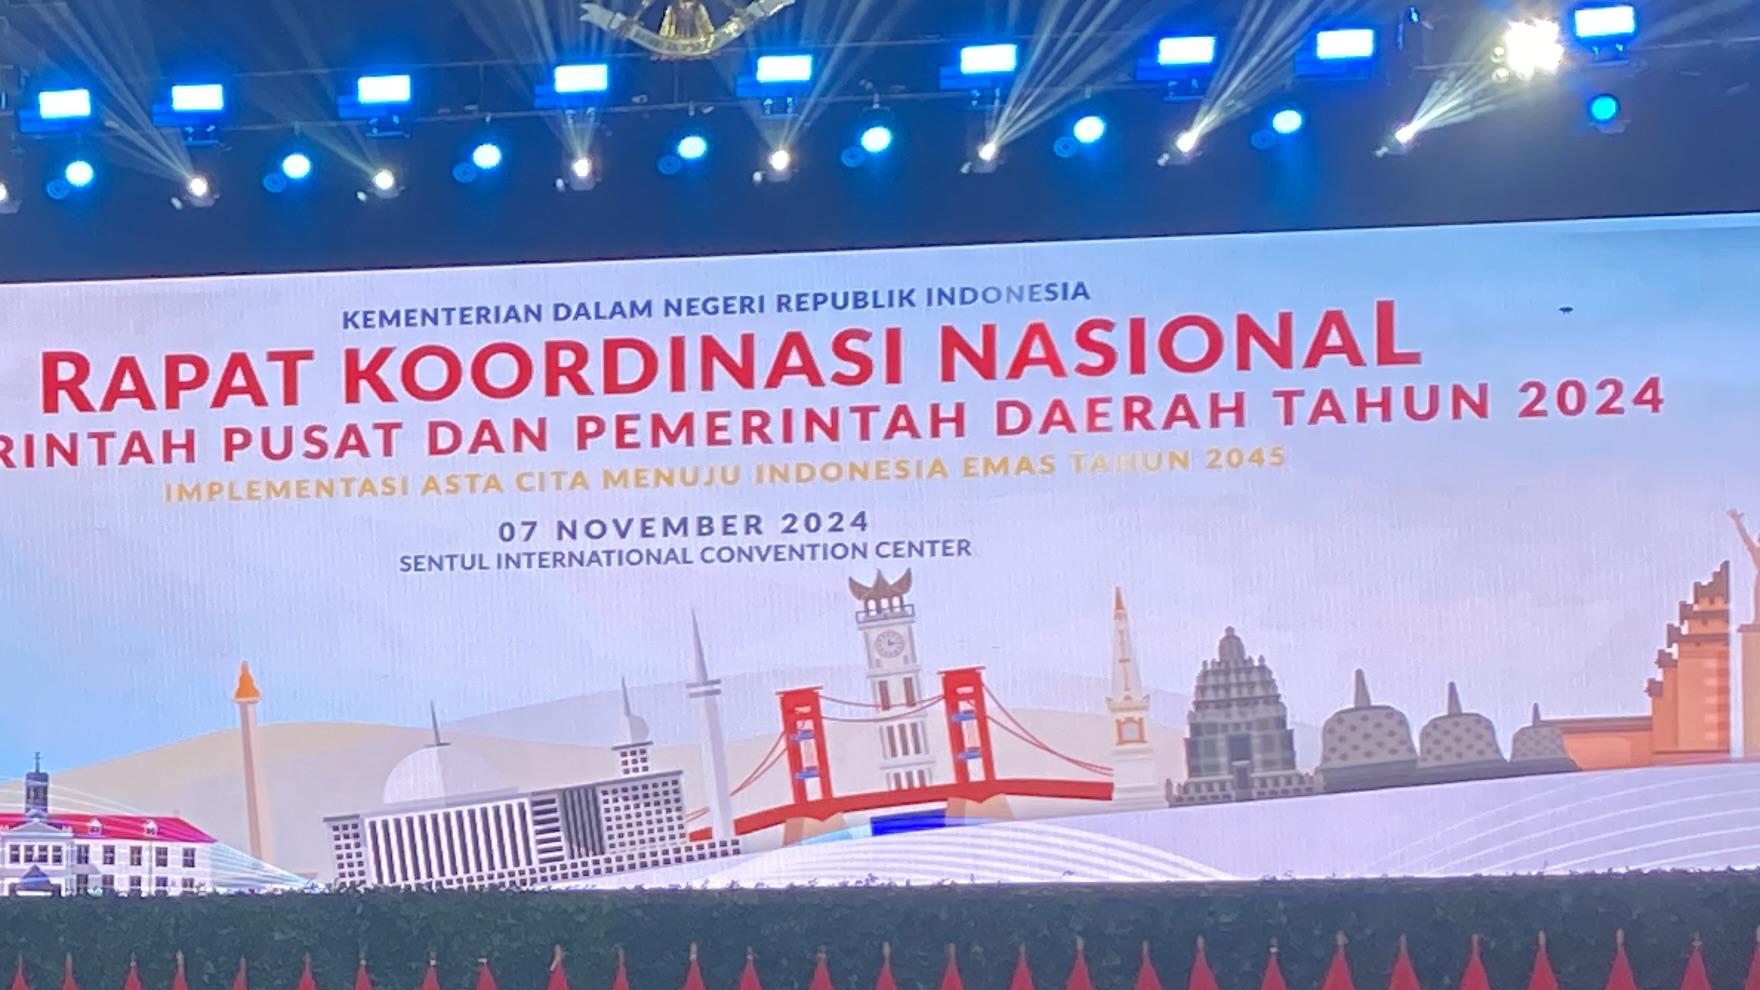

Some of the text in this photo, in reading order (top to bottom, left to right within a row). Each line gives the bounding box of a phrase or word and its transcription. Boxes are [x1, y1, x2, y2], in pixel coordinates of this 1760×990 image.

[343, 282, 1090, 329] KEMENTERIAN DALAM NEGERI REPUBLIK INDONESIA
[40, 298, 1421, 414] RAPAT KOORDINASI NASIONAL
[224, 422, 402, 462] PUSAT
[428, 417, 546, 457] DAN
[576, 402, 965, 451] PEMERINTAH
[997, 392, 1245, 436] DAERAH
[1273, 383, 1488, 426] TAHUN
[1519, 375, 1664, 419] 2024
[166, 447, 1284, 502] IMPLEMENTASI ASTA CITA MENUJU INDONESIA EMAS TAHUN 2045
[499, 511, 867, 542] 07 NOVEMBER 2024
[400, 539, 971, 572] SENTUL INTERNATIONAL CONVENTION CENTER
